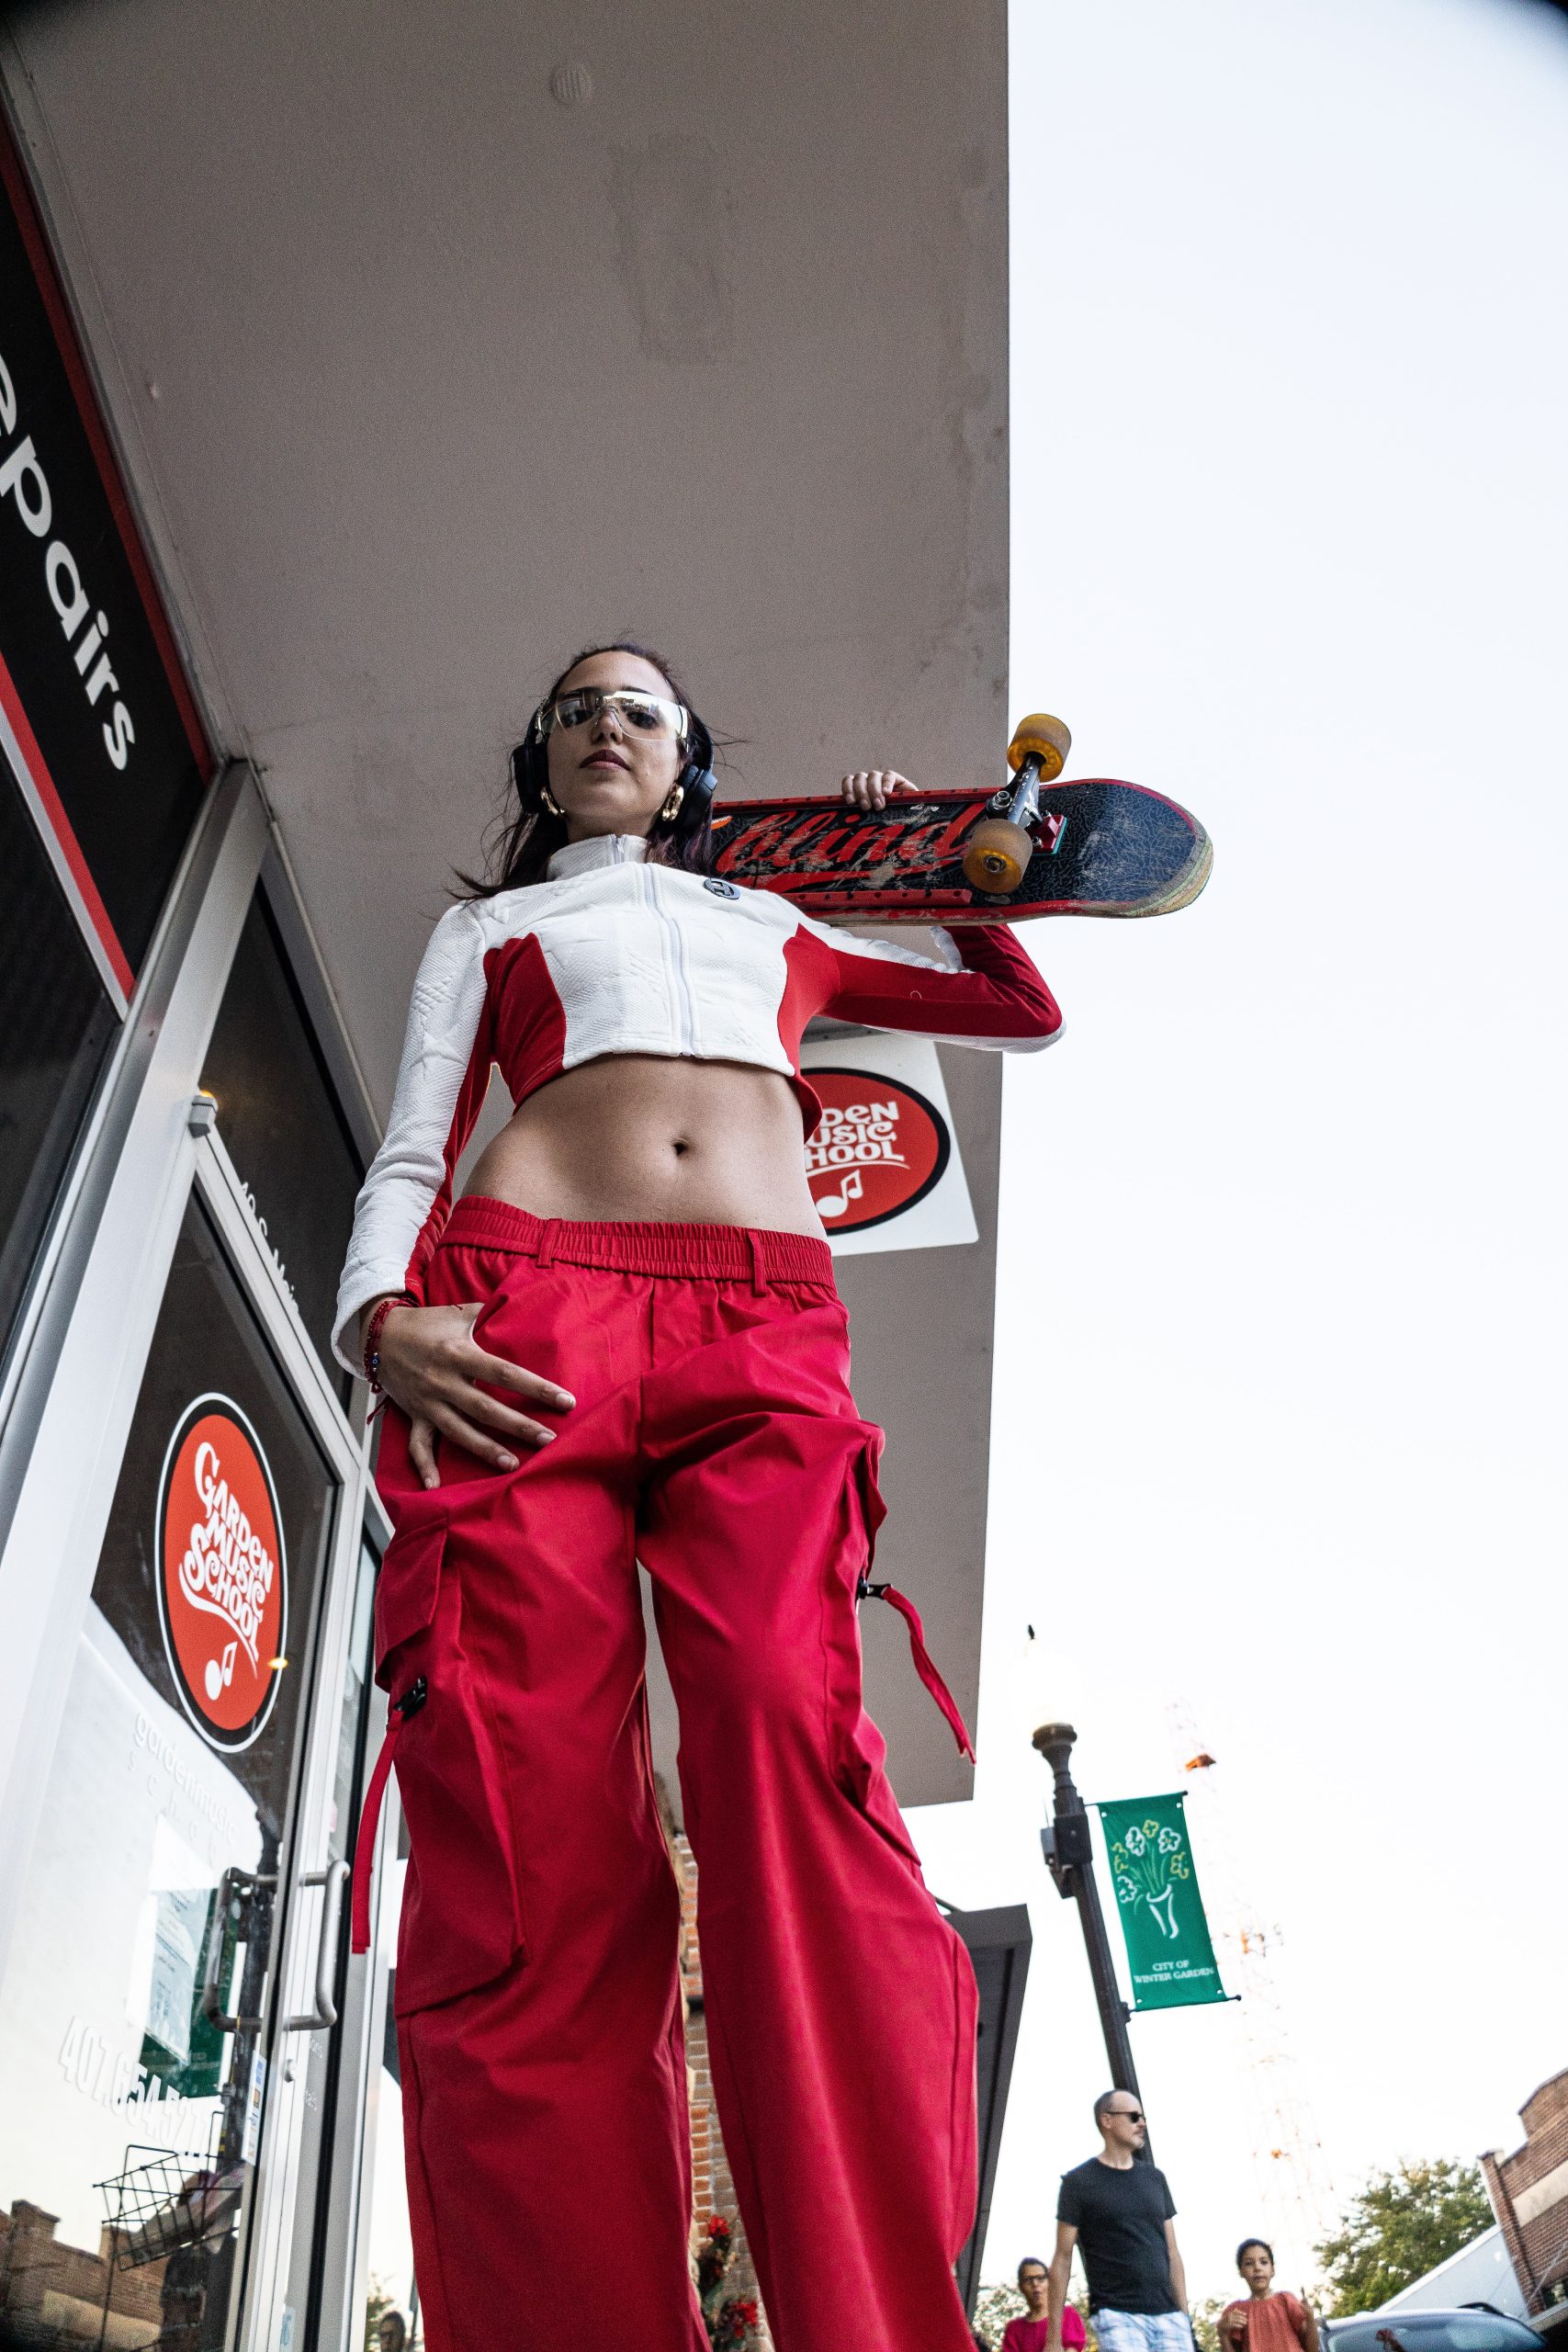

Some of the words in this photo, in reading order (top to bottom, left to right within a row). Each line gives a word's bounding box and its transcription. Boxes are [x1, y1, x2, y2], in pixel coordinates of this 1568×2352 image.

[819, 1101, 899, 1128] DEN
[807, 1121, 897, 1148] USIC
[804, 1140, 906, 1171] HOOL
[194, 1442, 274, 1592] GARDEN
[205, 1510, 265, 1623] MUSIC
[184, 1522, 260, 1662] SCHOOL
[1134, 1973, 1171, 1983] WINTER
[1173, 1967, 1214, 1979] GARDEN
[1152, 1962, 1174, 1972] CITY
[1176, 1960, 1190, 1969] OF
